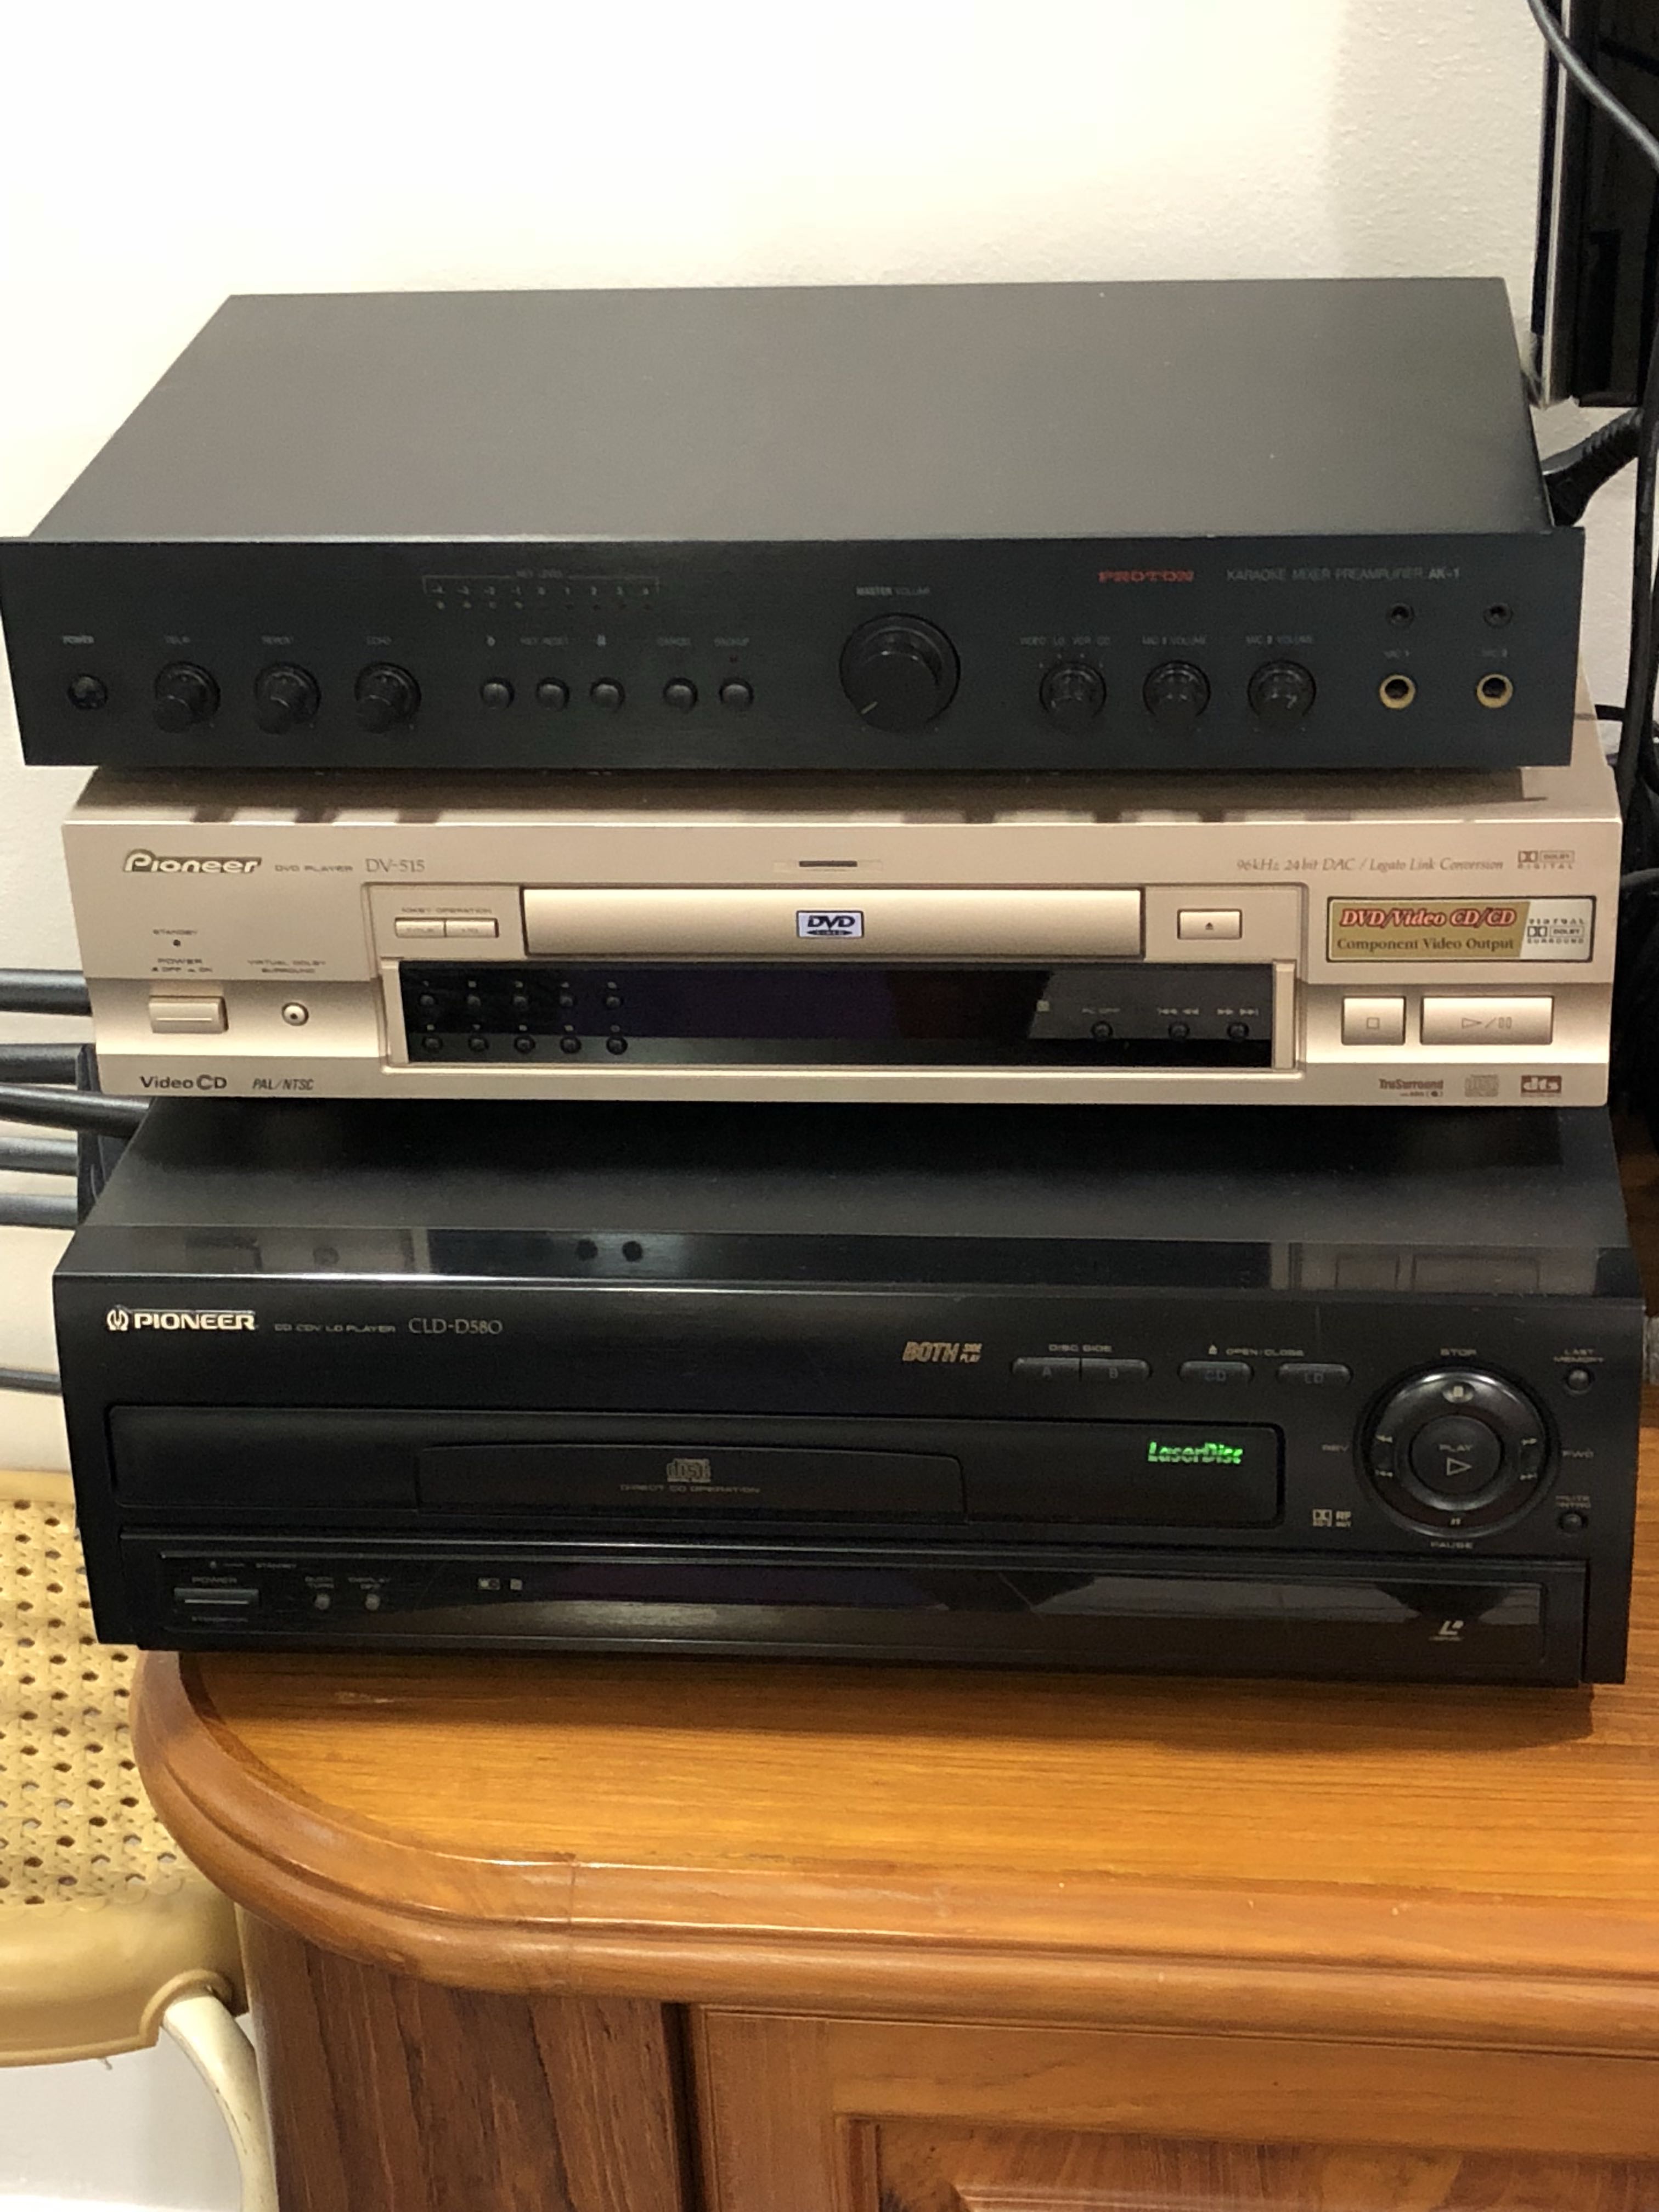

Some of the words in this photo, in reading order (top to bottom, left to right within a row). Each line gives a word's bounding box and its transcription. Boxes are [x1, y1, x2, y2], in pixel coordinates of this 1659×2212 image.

[1097, 569, 1194, 583] PROTON
[1226, 568, 1286, 582] KARAOKE
[1290, 568, 1331, 581] MIXER
[1335, 567, 1423, 580] PREAMPLIFIER
[1428, 567, 1460, 580] AK-1
[123, 850, 262, 873] Pioneer
[365, 857, 426, 873] DV-515
[1322, 857, 1356, 871] DAC
[1409, 857, 1434, 871] Link
[1439, 857, 1504, 871] Conversion
[304, 865, 353, 873] PLAYER
[808, 915, 856, 928] DVD
[1339, 907, 1447, 928] DVD/Video
[1449, 907, 1519, 928] CD/CD
[1336, 937, 1419, 953] Component
[1422, 937, 1462, 951] Video
[1465, 937, 1515, 953] Output
[252, 1077, 314, 1092] PAL/NTSC
[1378, 1078, 1443, 1090] TruSurround
[134, 1312, 256, 1330] PIONEER
[408, 1317, 503, 1334] CLD-D580
[346, 1324, 396, 1333] PLAYER
[902, 1341, 960, 1363] BOTH
[1048, 1344, 1079, 1352] DISC
[1440, 1348, 1477, 1357] STOP
[1042, 1366, 1053, 1378] A
[1148, 1442, 1243, 1464] LaserDisc
[1438, 1443, 1473, 1453] PLAY
[1430, 1541, 1473, 1549] PAUSE
